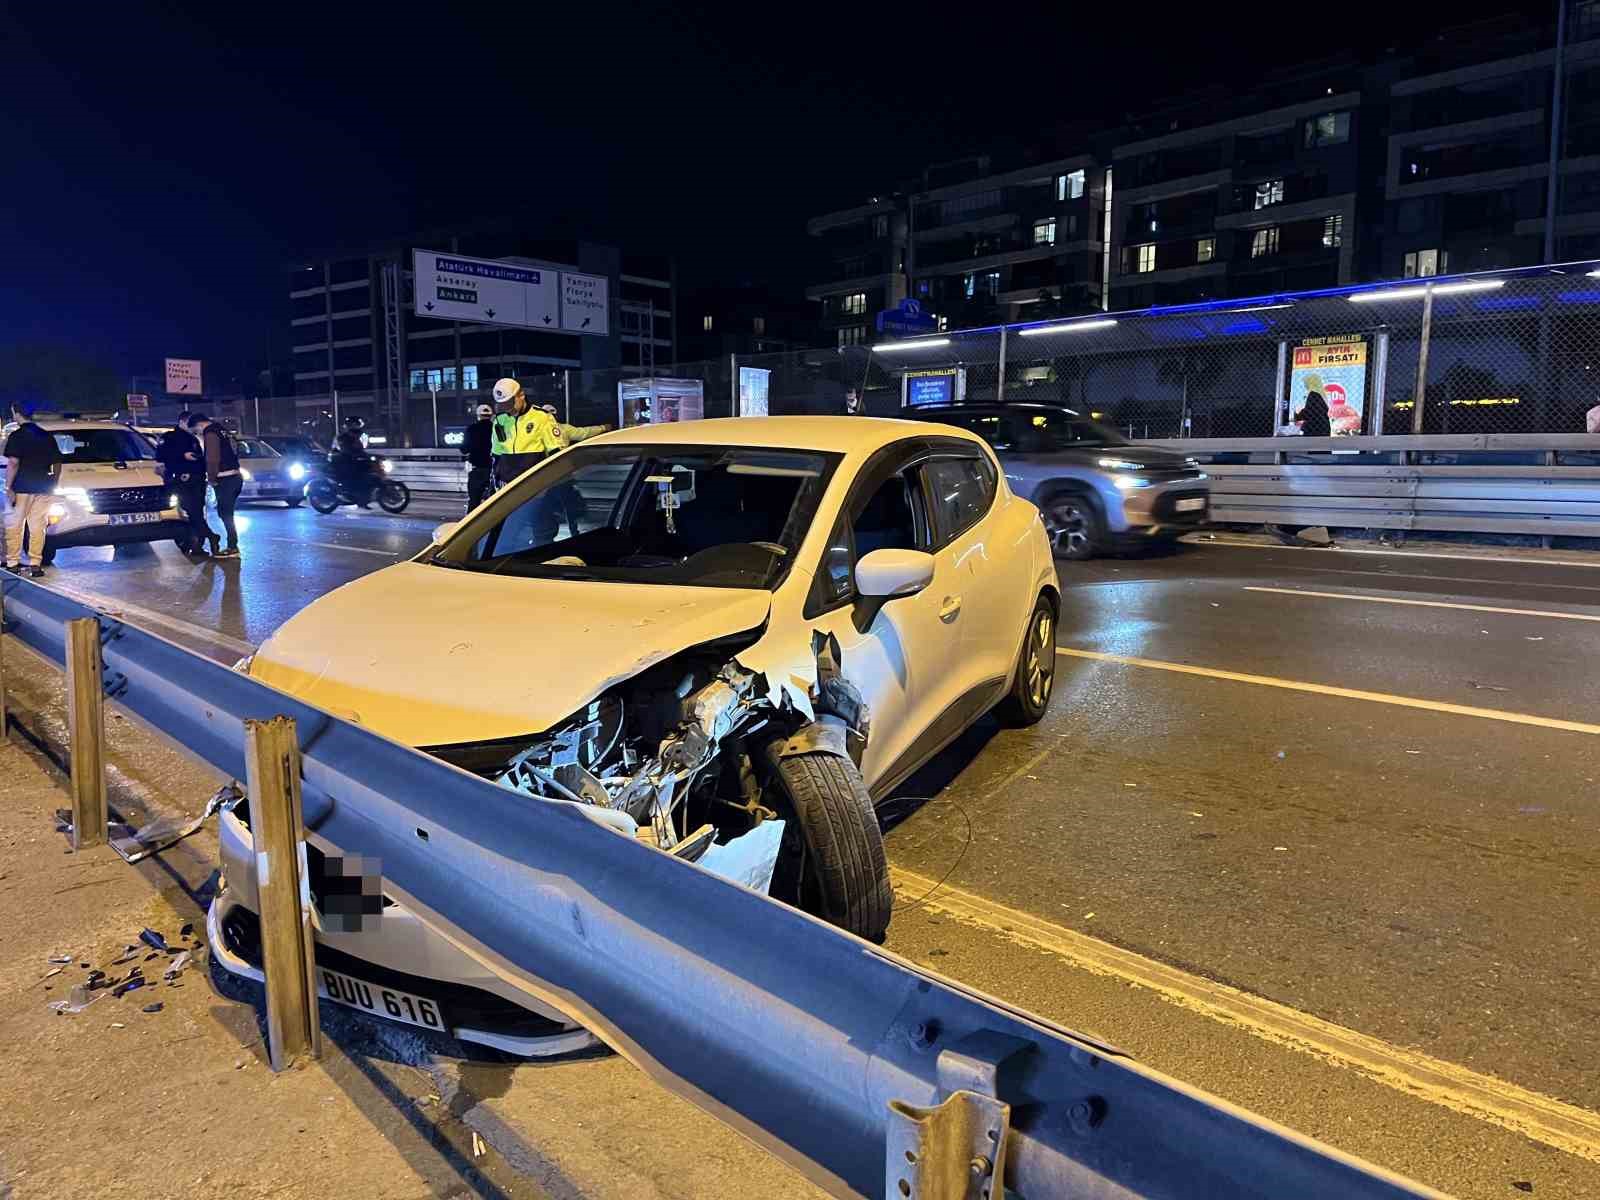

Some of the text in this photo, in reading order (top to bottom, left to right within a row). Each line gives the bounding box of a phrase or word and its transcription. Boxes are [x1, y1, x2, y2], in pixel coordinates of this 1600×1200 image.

[438, 260, 474, 273] Atatürk
[436, 274, 477, 289] Aksaray
[439, 289, 476, 302] Ankara
[1319, 353, 1358, 363] FIRSATI
[324, 971, 438, 1027] BUU 616
